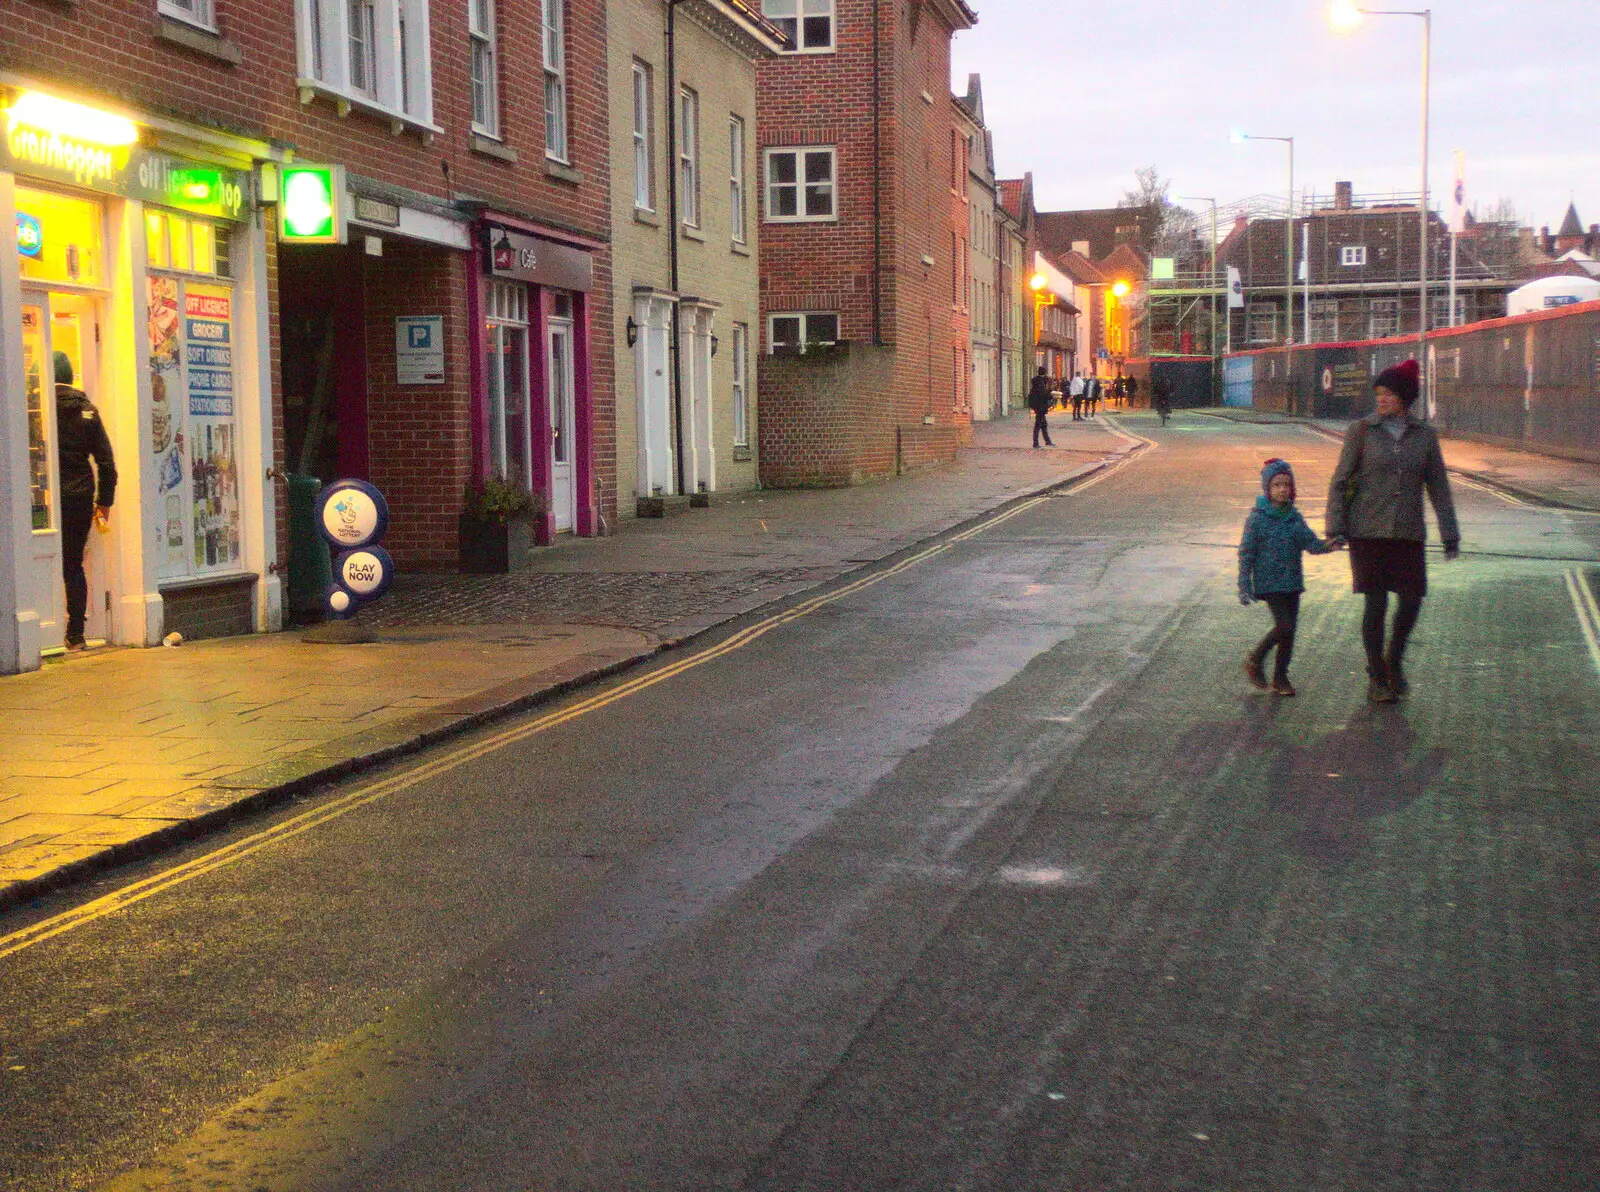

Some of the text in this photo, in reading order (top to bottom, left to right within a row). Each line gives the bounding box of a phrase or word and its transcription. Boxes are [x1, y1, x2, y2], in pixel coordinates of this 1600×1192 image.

[192, 322, 224, 339] GROCERY
[187, 346, 205, 362] SOFT
[349, 563, 375, 573] PLAY
[349, 572, 375, 581] NOW
